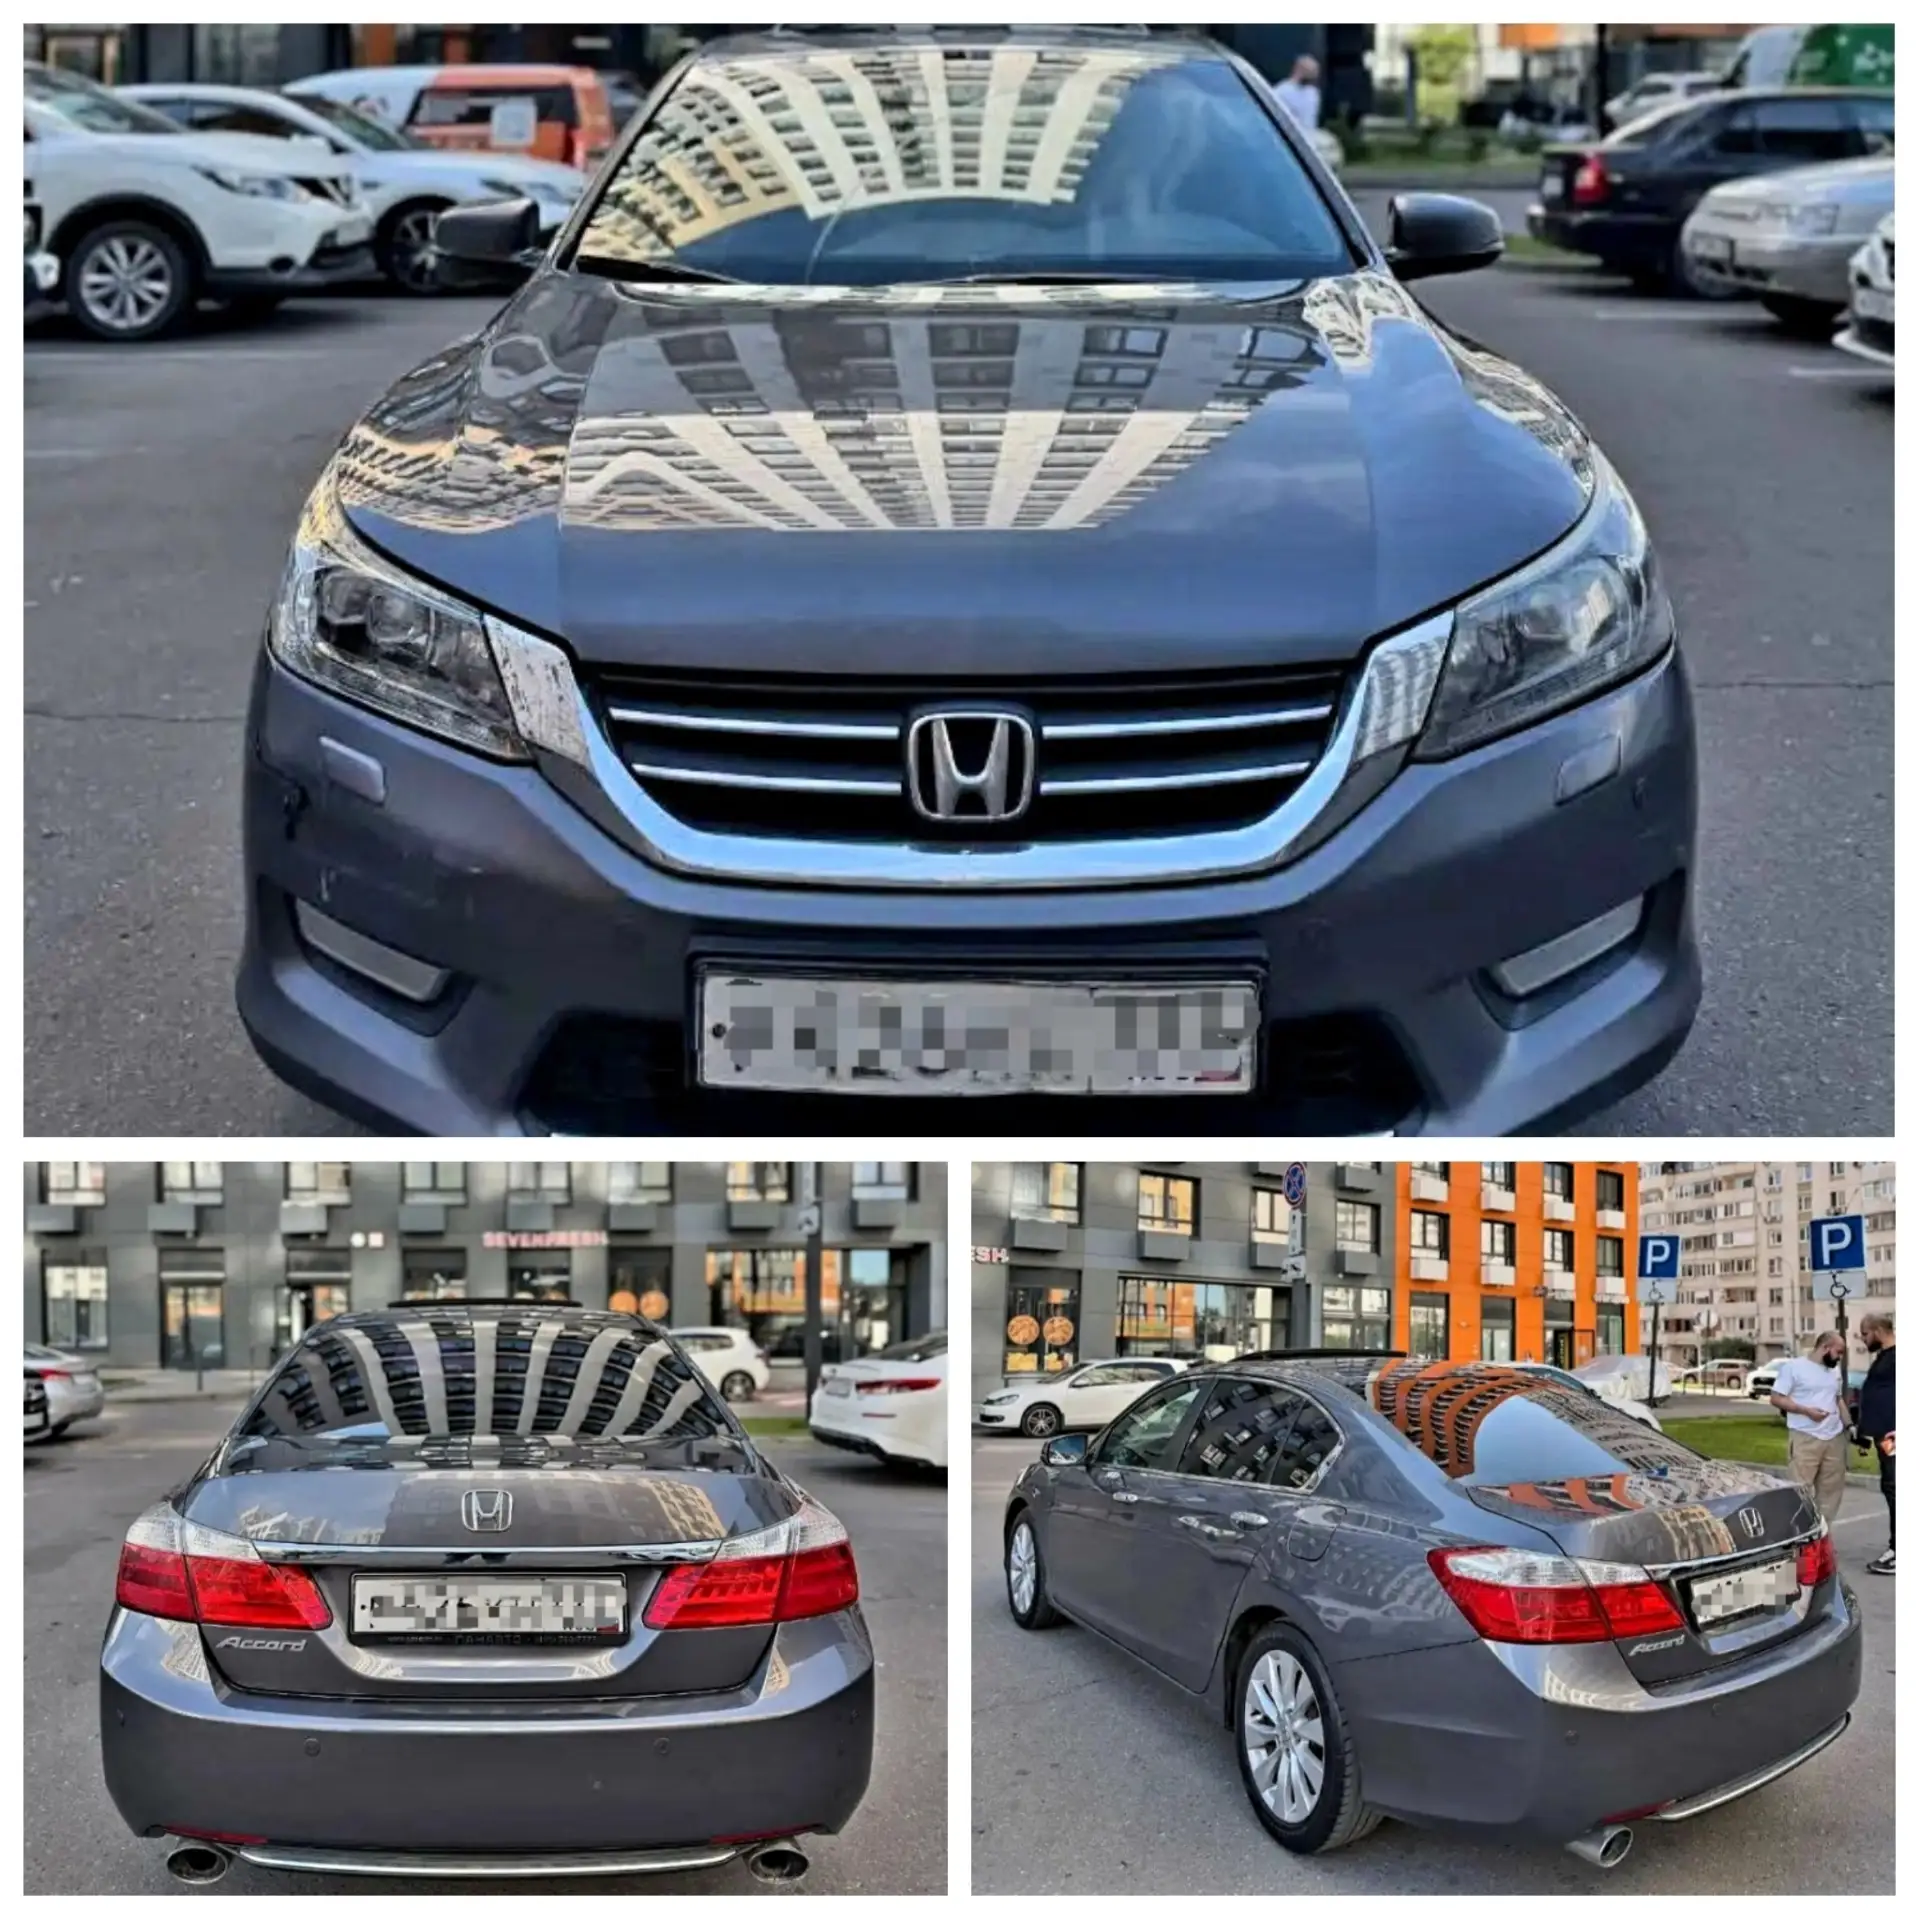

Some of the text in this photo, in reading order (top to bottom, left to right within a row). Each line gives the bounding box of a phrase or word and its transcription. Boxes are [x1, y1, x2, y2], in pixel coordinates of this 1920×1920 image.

[1645, 1239, 1671, 1274] P
[1821, 1223, 1851, 1266] P
[216, 1636, 307, 1652] Accord
[1628, 1634, 1685, 1657] Accord
